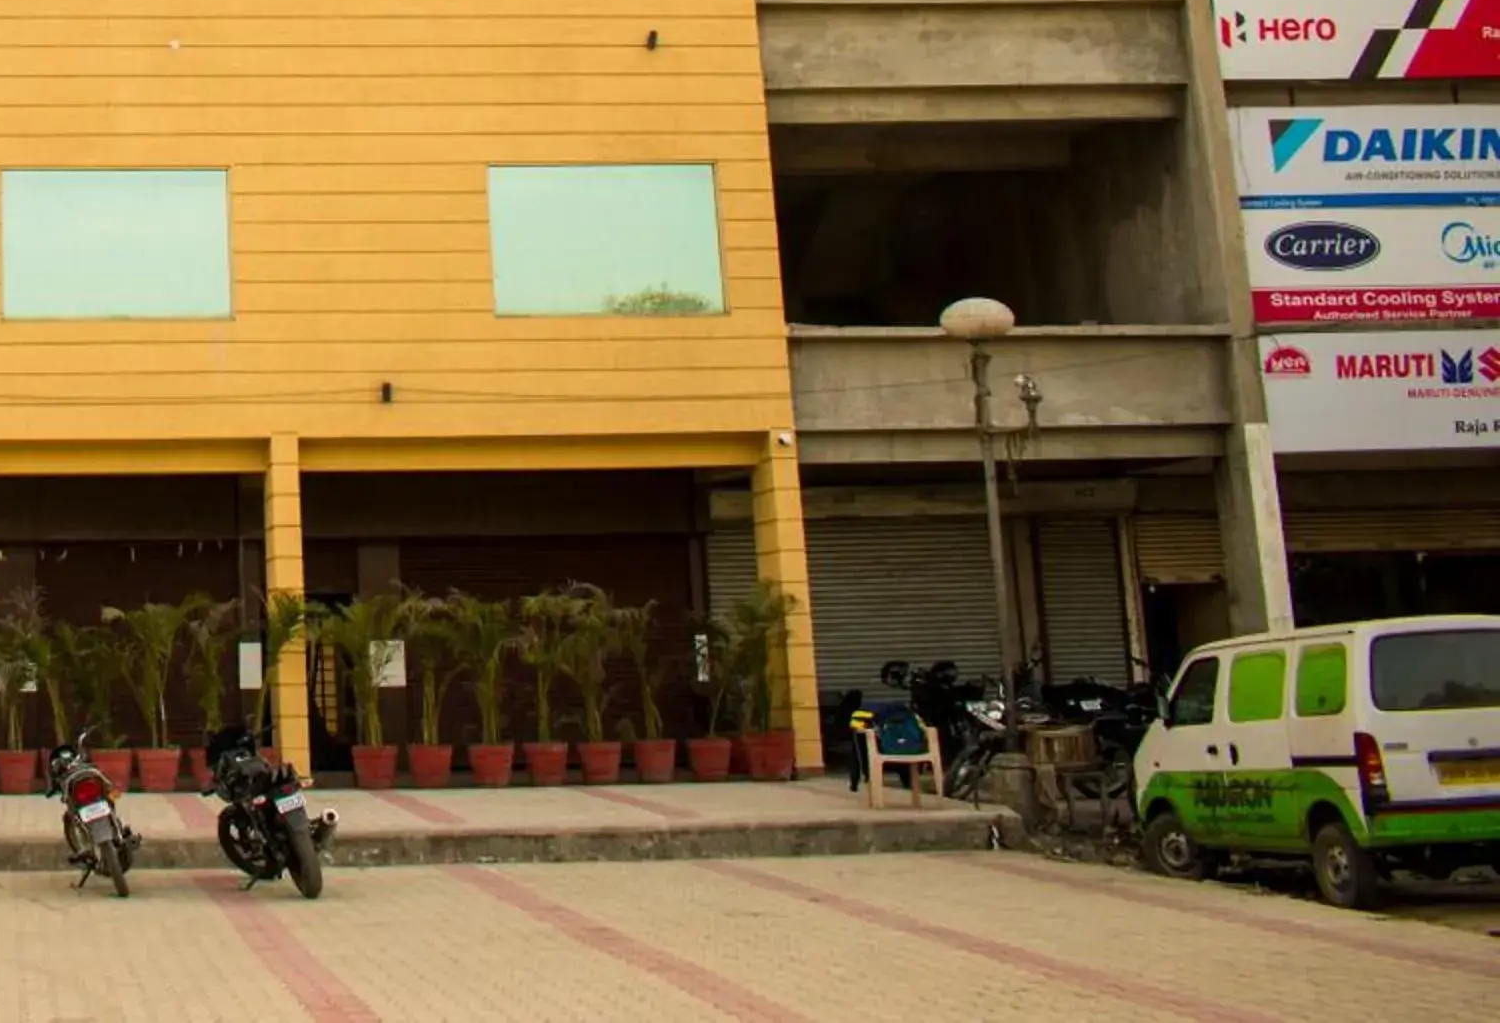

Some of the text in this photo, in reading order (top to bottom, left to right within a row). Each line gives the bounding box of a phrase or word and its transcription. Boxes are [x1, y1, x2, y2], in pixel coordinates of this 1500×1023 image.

[1258, 17, 1337, 41] Hero
[1322, 128, 1500, 161] DAIKIN
[1274, 233, 1371, 256] Carrier
[1270, 292, 1357, 307] Standard
[1363, 291, 1437, 308] Cooling
[1336, 353, 1435, 379] MARUTI
[1455, 420, 1488, 436] Raja
